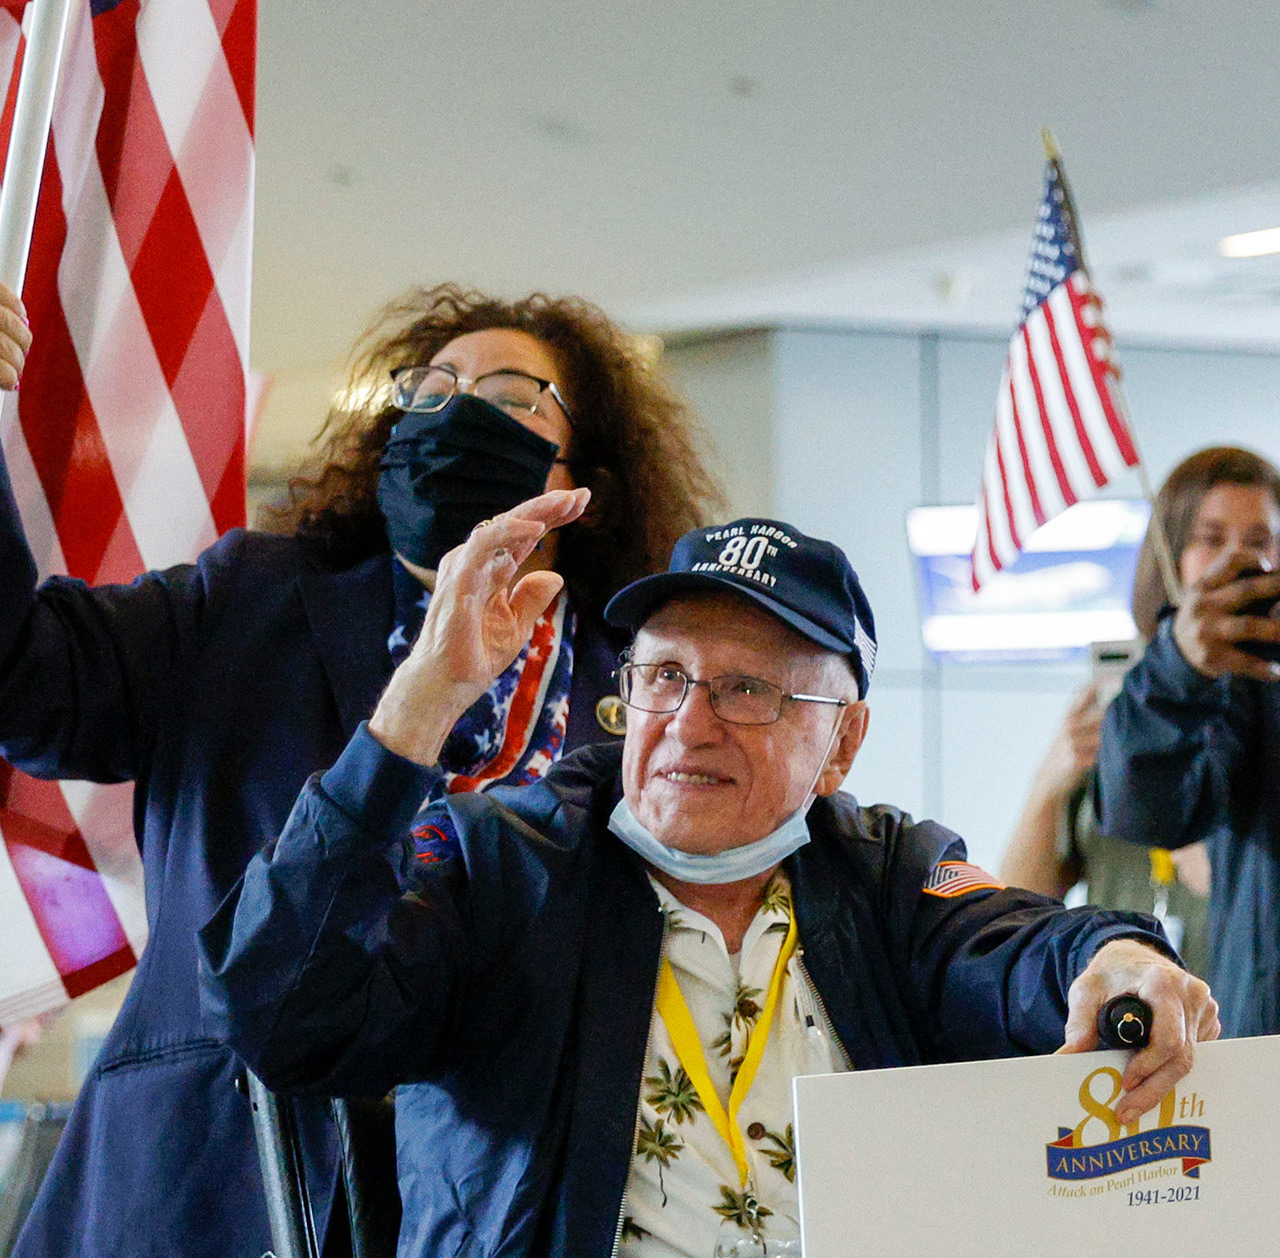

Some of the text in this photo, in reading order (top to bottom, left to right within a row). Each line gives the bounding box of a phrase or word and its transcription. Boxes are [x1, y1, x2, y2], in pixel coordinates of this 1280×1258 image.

[706, 524, 798, 549] PEARL HARBOR
[691, 562, 777, 588] ANNIVERSARY
[1055, 1133, 1204, 1174] ANNIVERSARY
[1047, 1165, 1179, 1198] Attack on Pearl Harbor
[1126, 1185, 1201, 1207] 1941-2021
